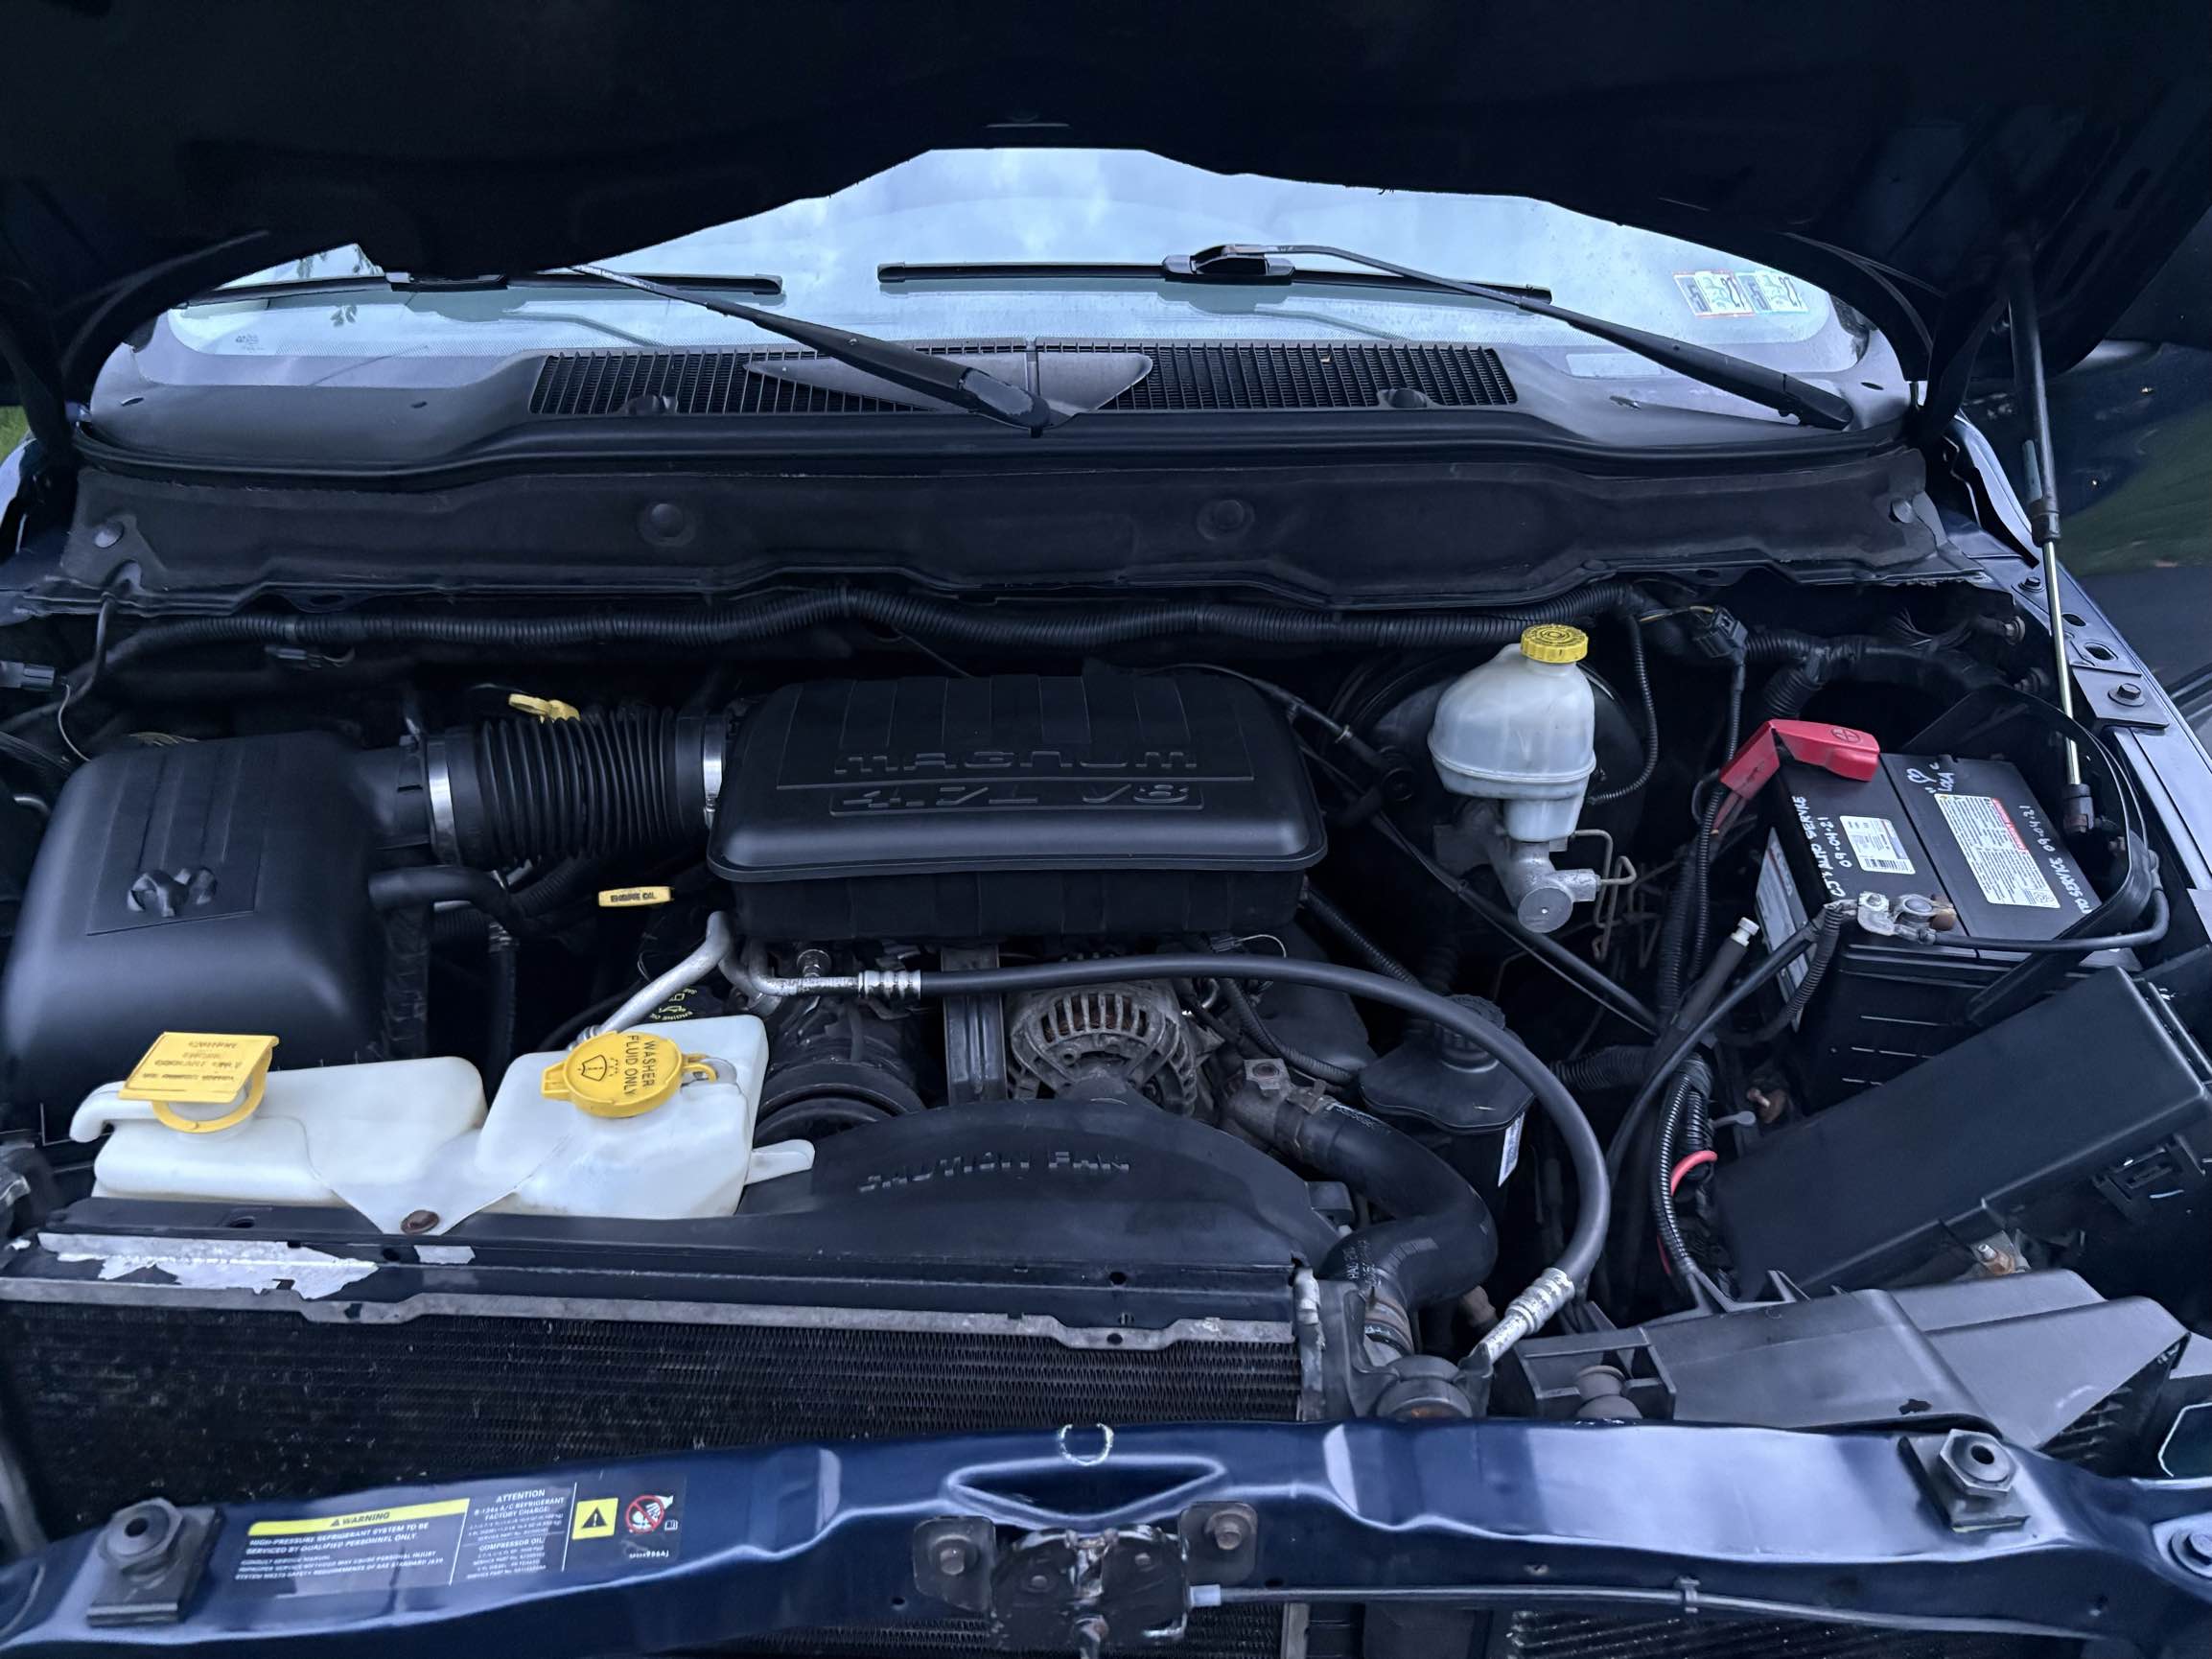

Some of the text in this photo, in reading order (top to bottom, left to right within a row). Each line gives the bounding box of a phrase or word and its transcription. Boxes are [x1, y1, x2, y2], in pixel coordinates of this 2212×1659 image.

[833, 748, 1198, 774] MAGNUM
[843, 782, 1190, 808] 4.7L V8
[623, 1035, 640, 1095] FLUID ONLY
[641, 1040, 657, 1087] WASHER
[1048, 1150, 1130, 1174] FAN
[496, 1488, 546, 1504] ATTENTION
[515, 1497, 565, 1509] REFRIGERANT
[342, 1512, 390, 1526] WARNING
[249, 1522, 430, 1547] HIGH-PRESSURE REFRIGERANT SYSTEM TO BE
[344, 1536, 393, 1549] PERSONNEL
[478, 1539, 529, 1552] COMPRESSOR
